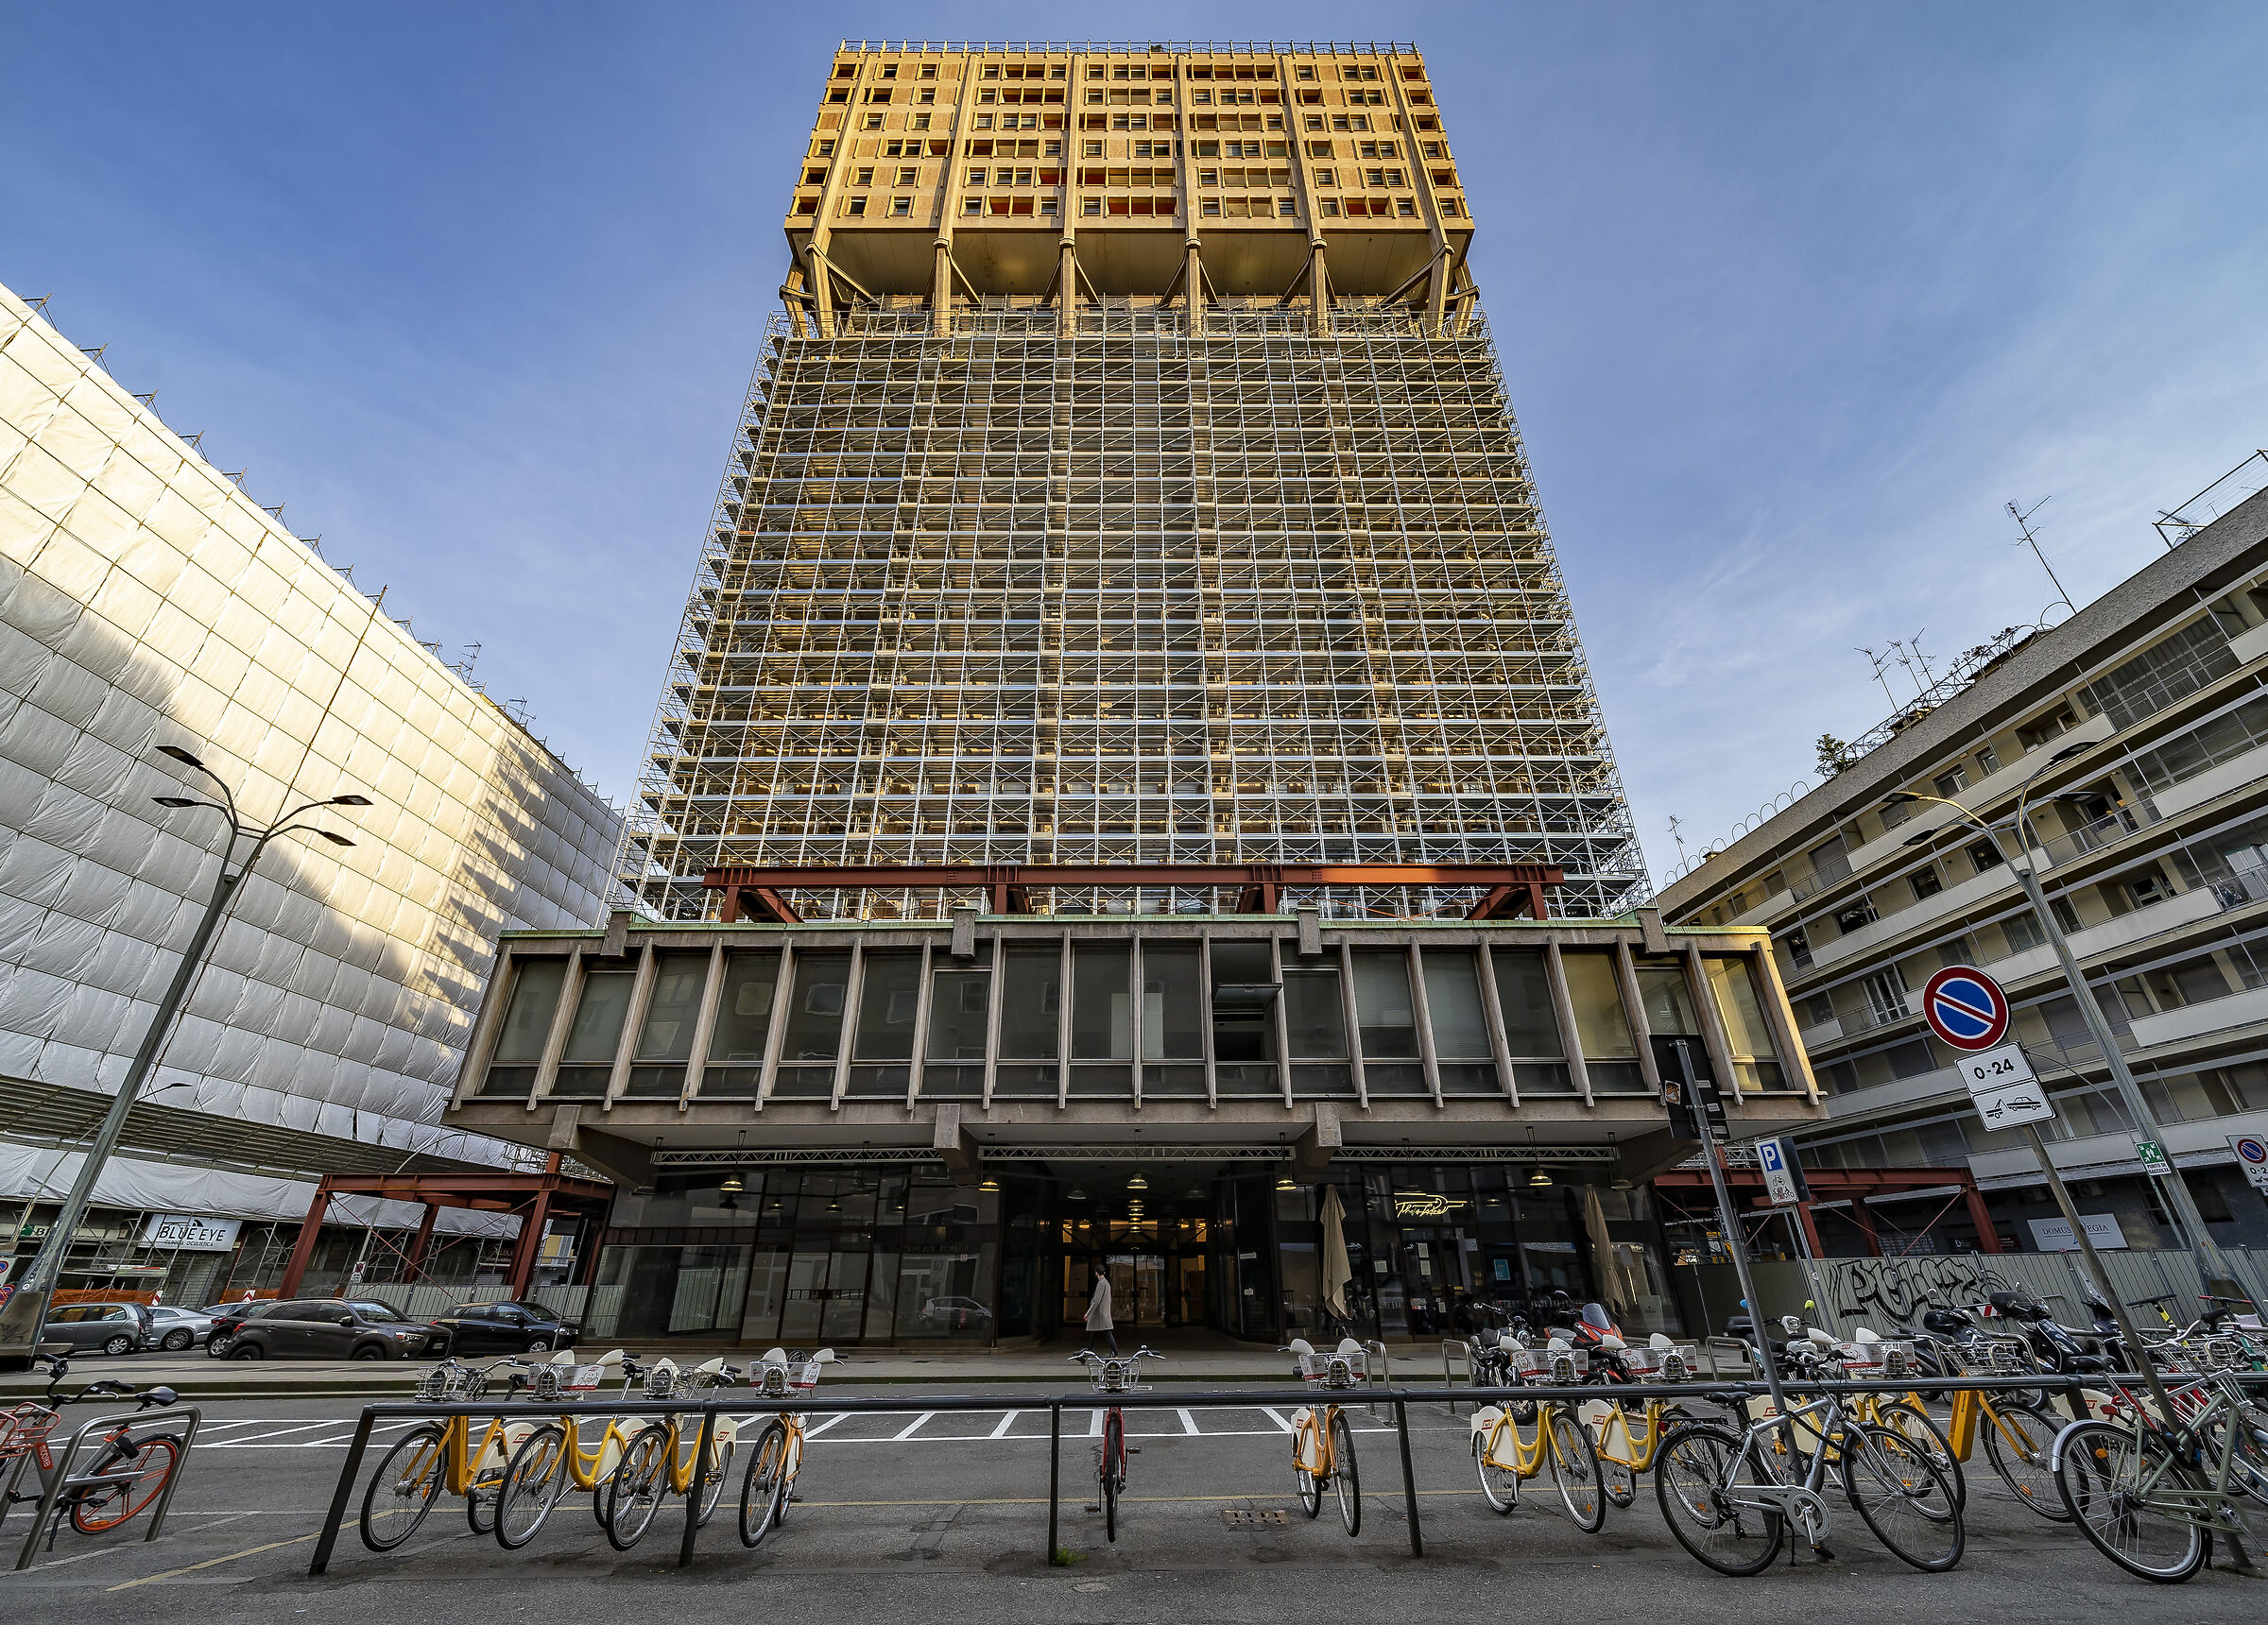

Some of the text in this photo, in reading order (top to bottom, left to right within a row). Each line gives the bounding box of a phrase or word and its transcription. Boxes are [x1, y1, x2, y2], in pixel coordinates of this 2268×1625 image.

[1974, 1058, 2014, 1079] 0-24
[1762, 1146, 1777, 1170] P
[159, 1225, 226, 1241] BLUE EYE
[2042, 1225, 2072, 1235] DOMUS
